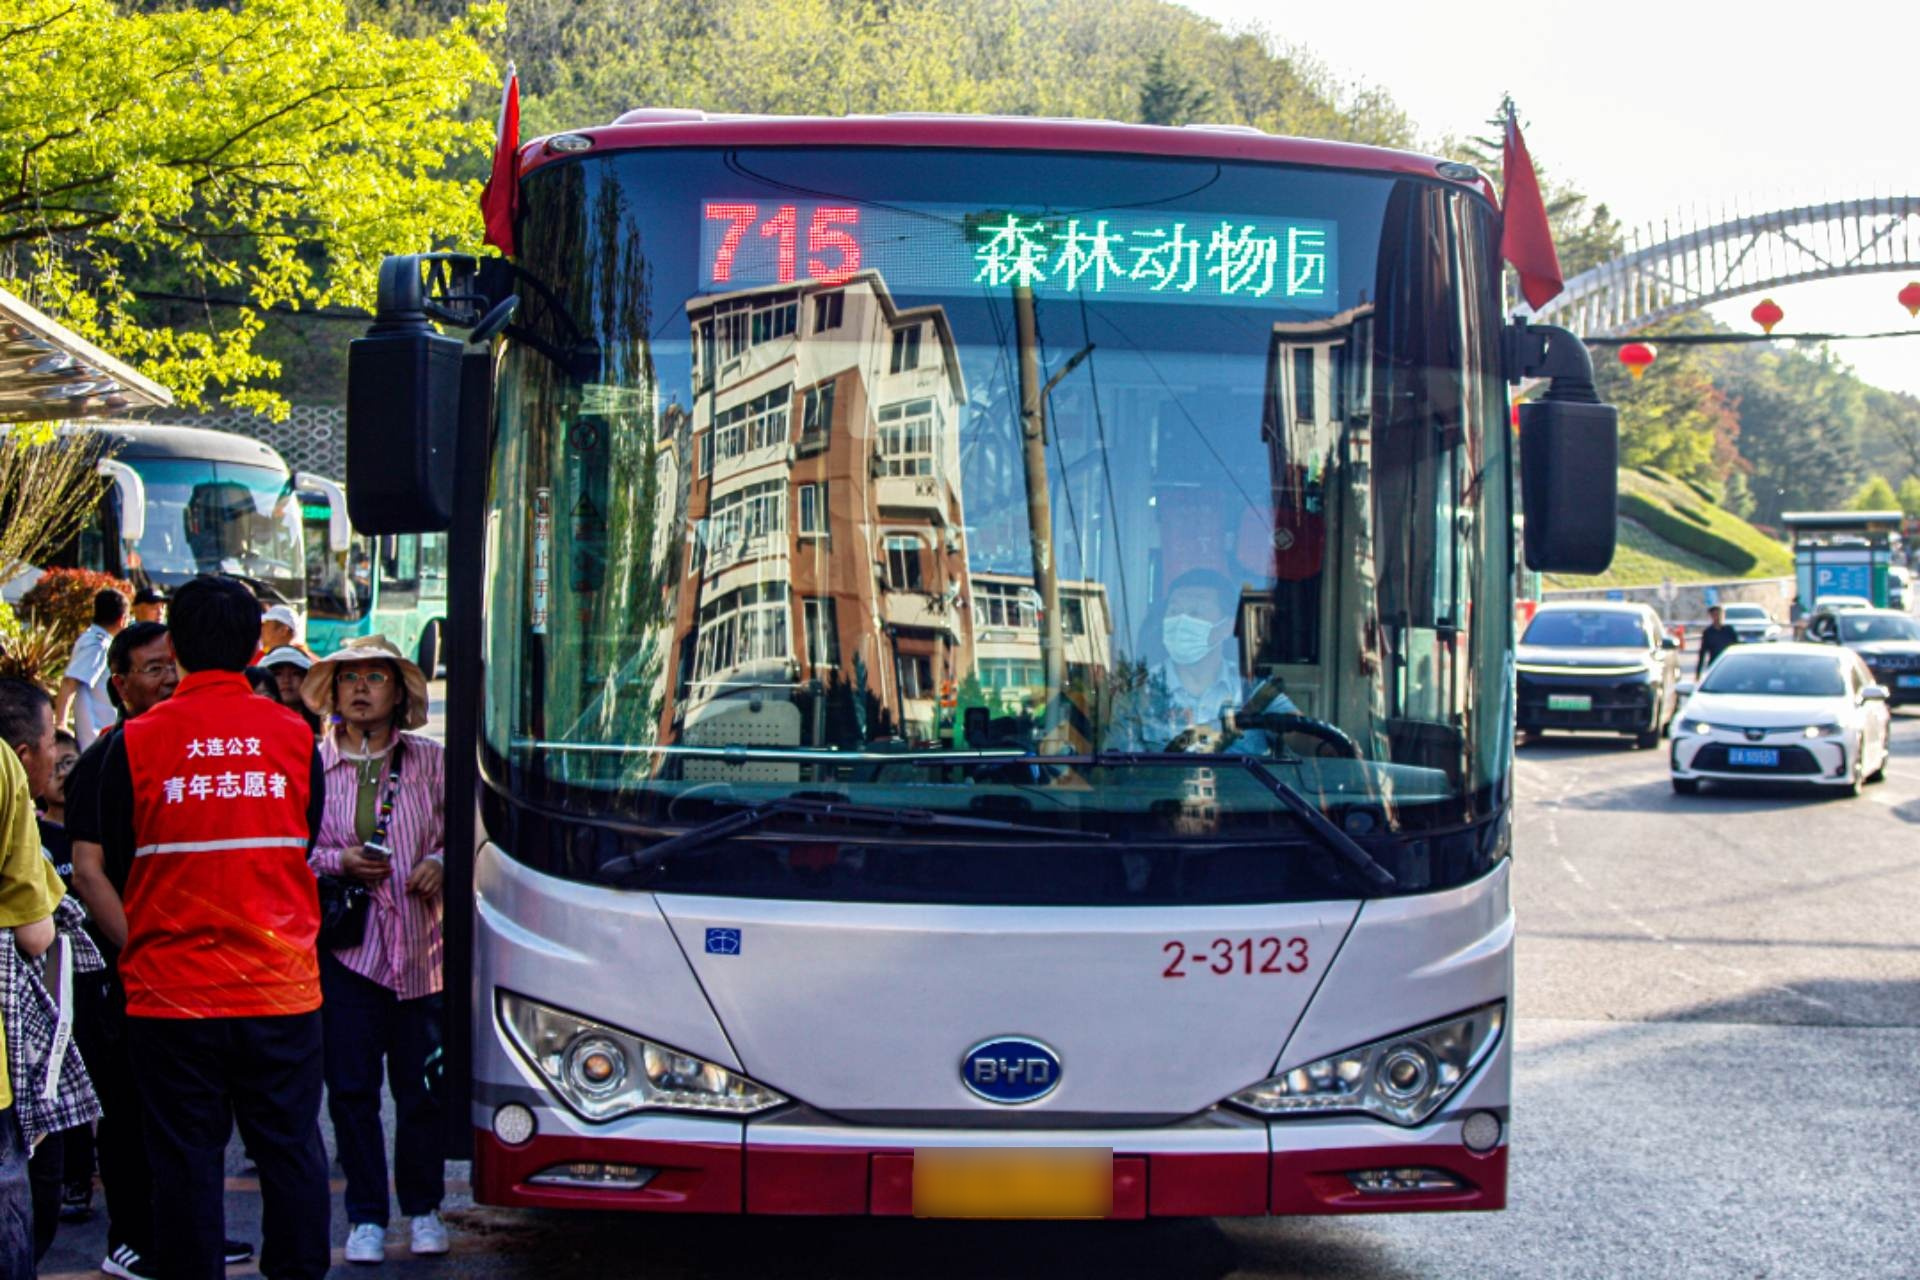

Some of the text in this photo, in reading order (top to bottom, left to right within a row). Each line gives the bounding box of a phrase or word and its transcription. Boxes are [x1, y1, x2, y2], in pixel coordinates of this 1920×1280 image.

[704, 203, 862, 285] 715
[973, 213, 1326, 298] 森林动物园
[186, 736, 261, 759] 大连公交
[163, 770, 288, 804] 青年志愿者
[1162, 936, 1309, 978] 2-3123
[973, 1057, 1051, 1084] BYD
